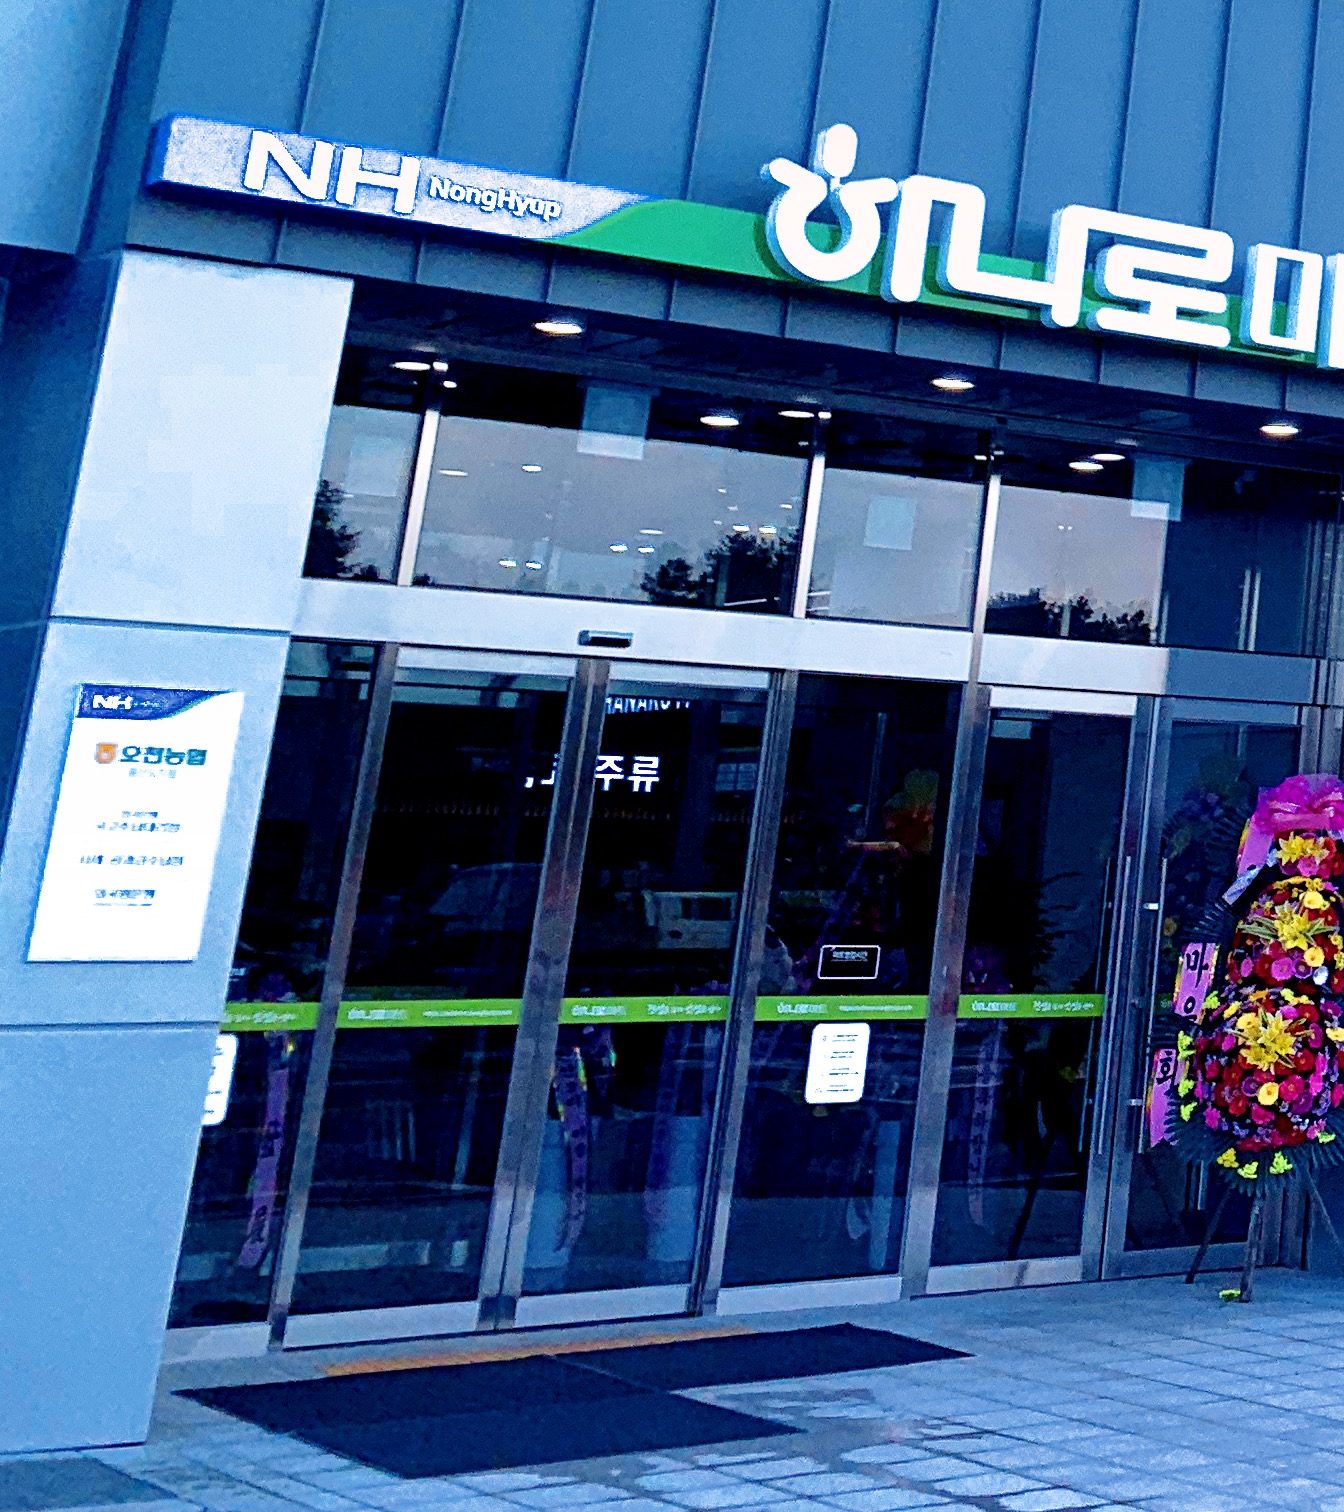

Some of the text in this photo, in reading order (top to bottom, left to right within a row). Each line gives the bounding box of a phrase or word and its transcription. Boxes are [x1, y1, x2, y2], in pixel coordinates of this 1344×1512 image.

[242, 129, 562, 222] NH NongHyup
[92, 694, 134, 710] NH
[594, 755, 660, 792] 주류
